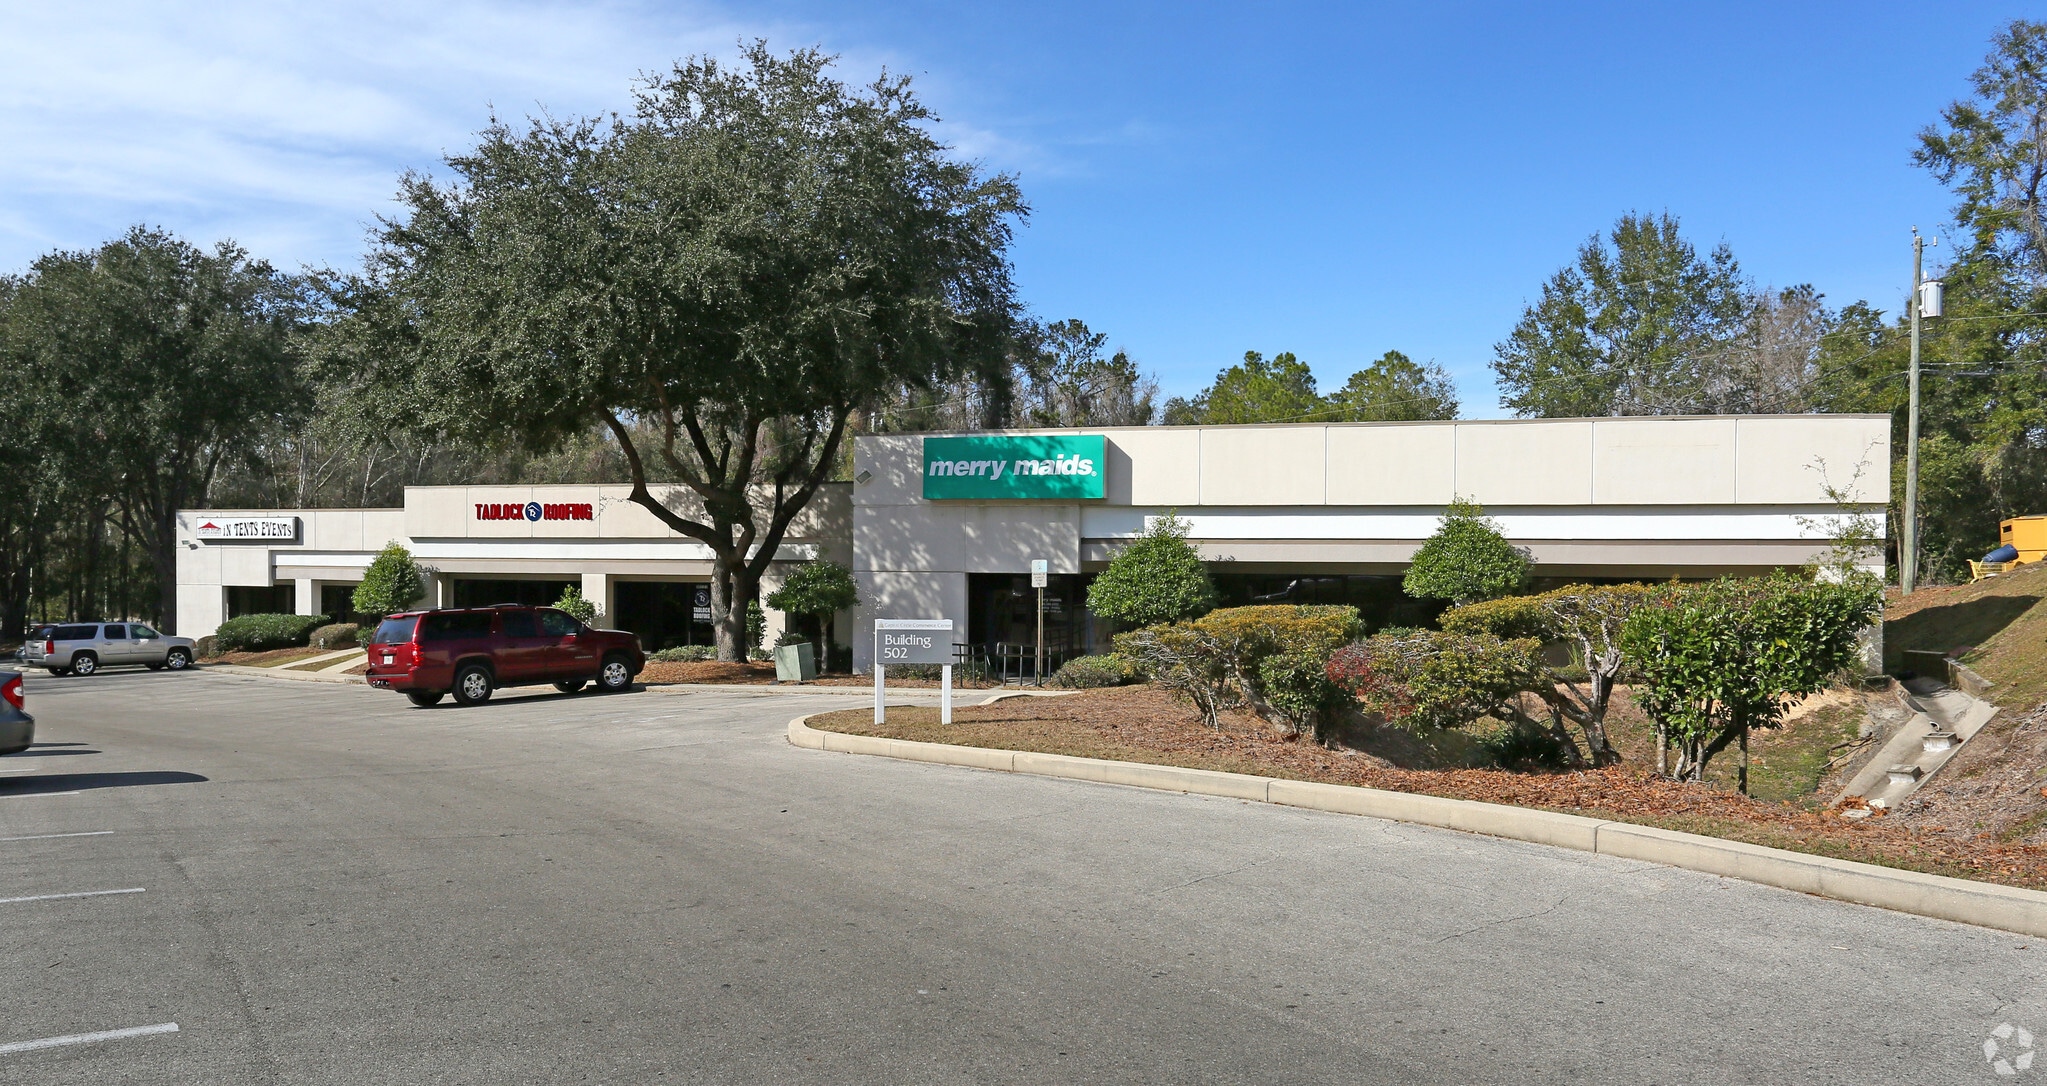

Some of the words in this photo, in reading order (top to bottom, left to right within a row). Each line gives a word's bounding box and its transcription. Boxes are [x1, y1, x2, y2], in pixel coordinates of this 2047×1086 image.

[929, 459, 1007, 481] merry
[475, 503, 525, 520] TADLOCK
[543, 503, 593, 520] ROOFING
[234, 521, 259, 536] TENTS
[261, 521, 292, 537] EVENTS
[885, 634, 931, 648] Building
[884, 648, 908, 658] 502
